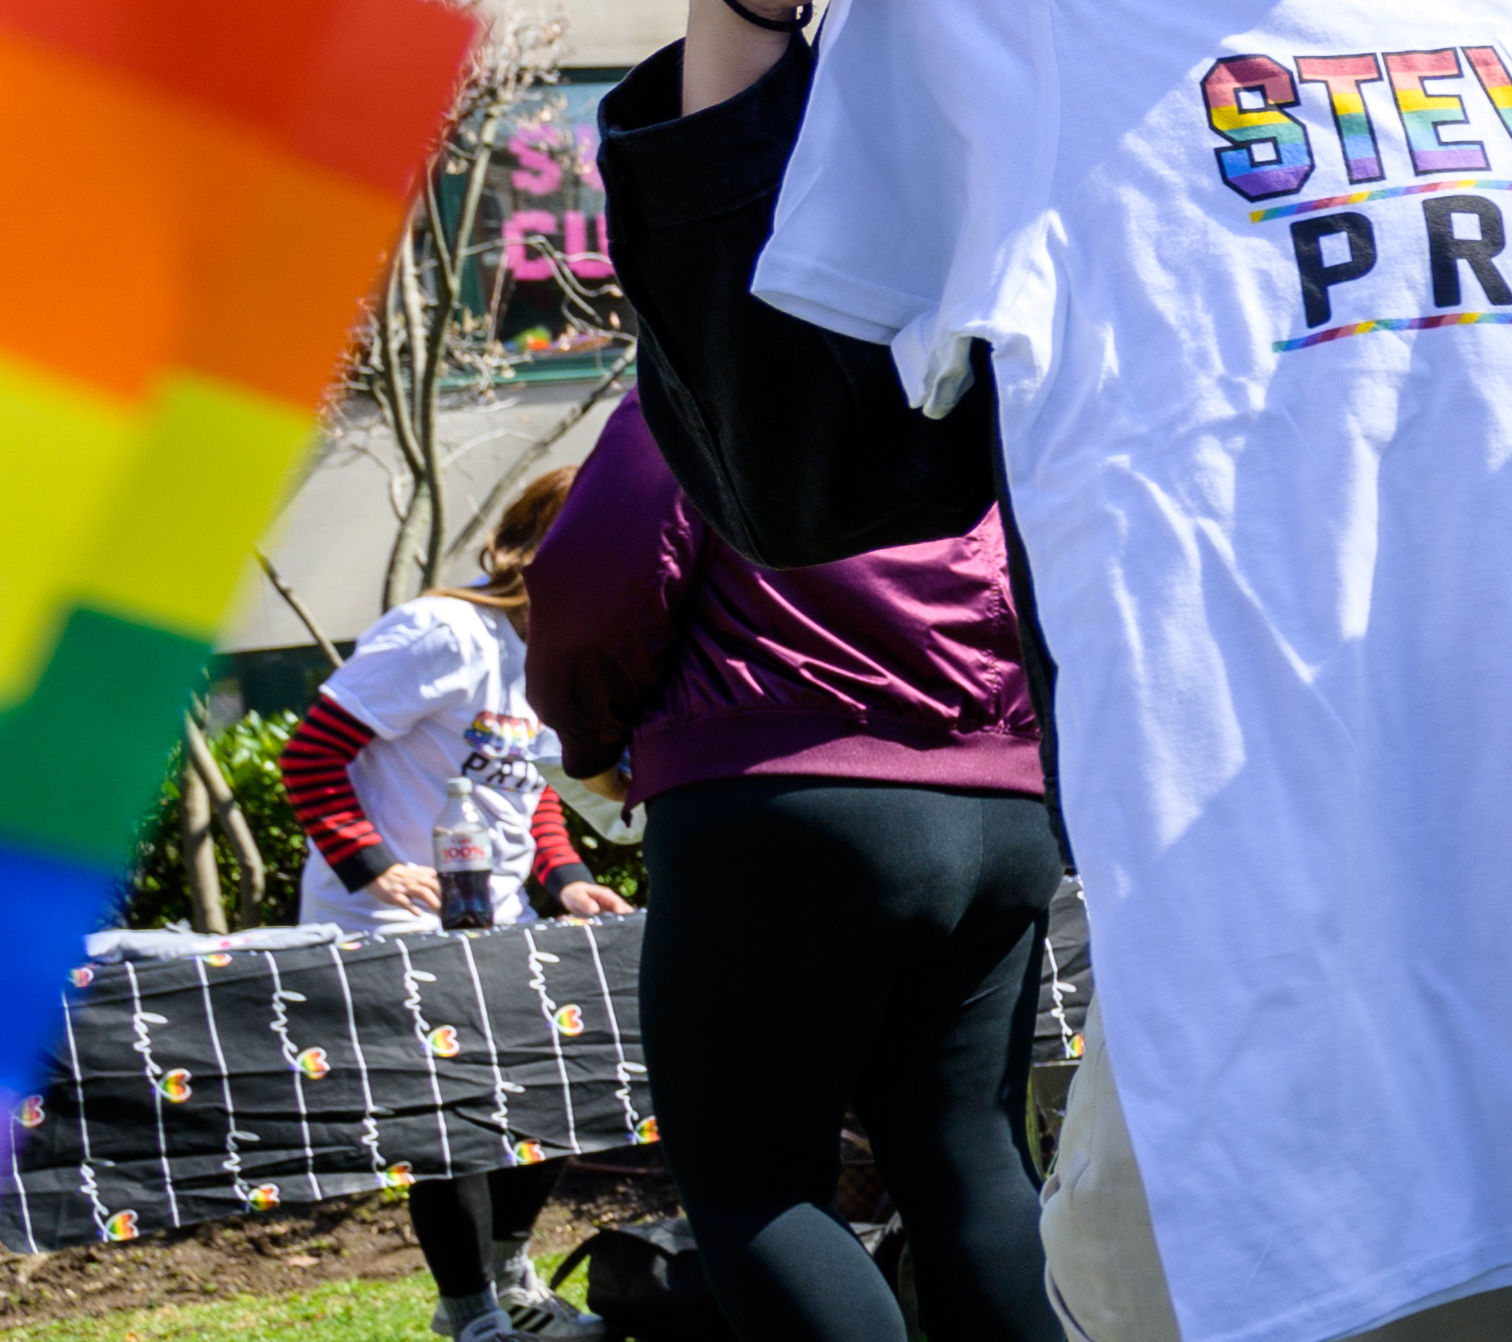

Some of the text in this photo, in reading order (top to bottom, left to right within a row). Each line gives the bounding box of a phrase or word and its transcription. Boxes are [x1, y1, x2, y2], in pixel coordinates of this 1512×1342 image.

[461, 751, 540, 790] PRI
[404, 969, 437, 1032] love
[529, 950, 561, 1011] love
[133, 1010, 170, 1078] love
[270, 989, 308, 1055] love
